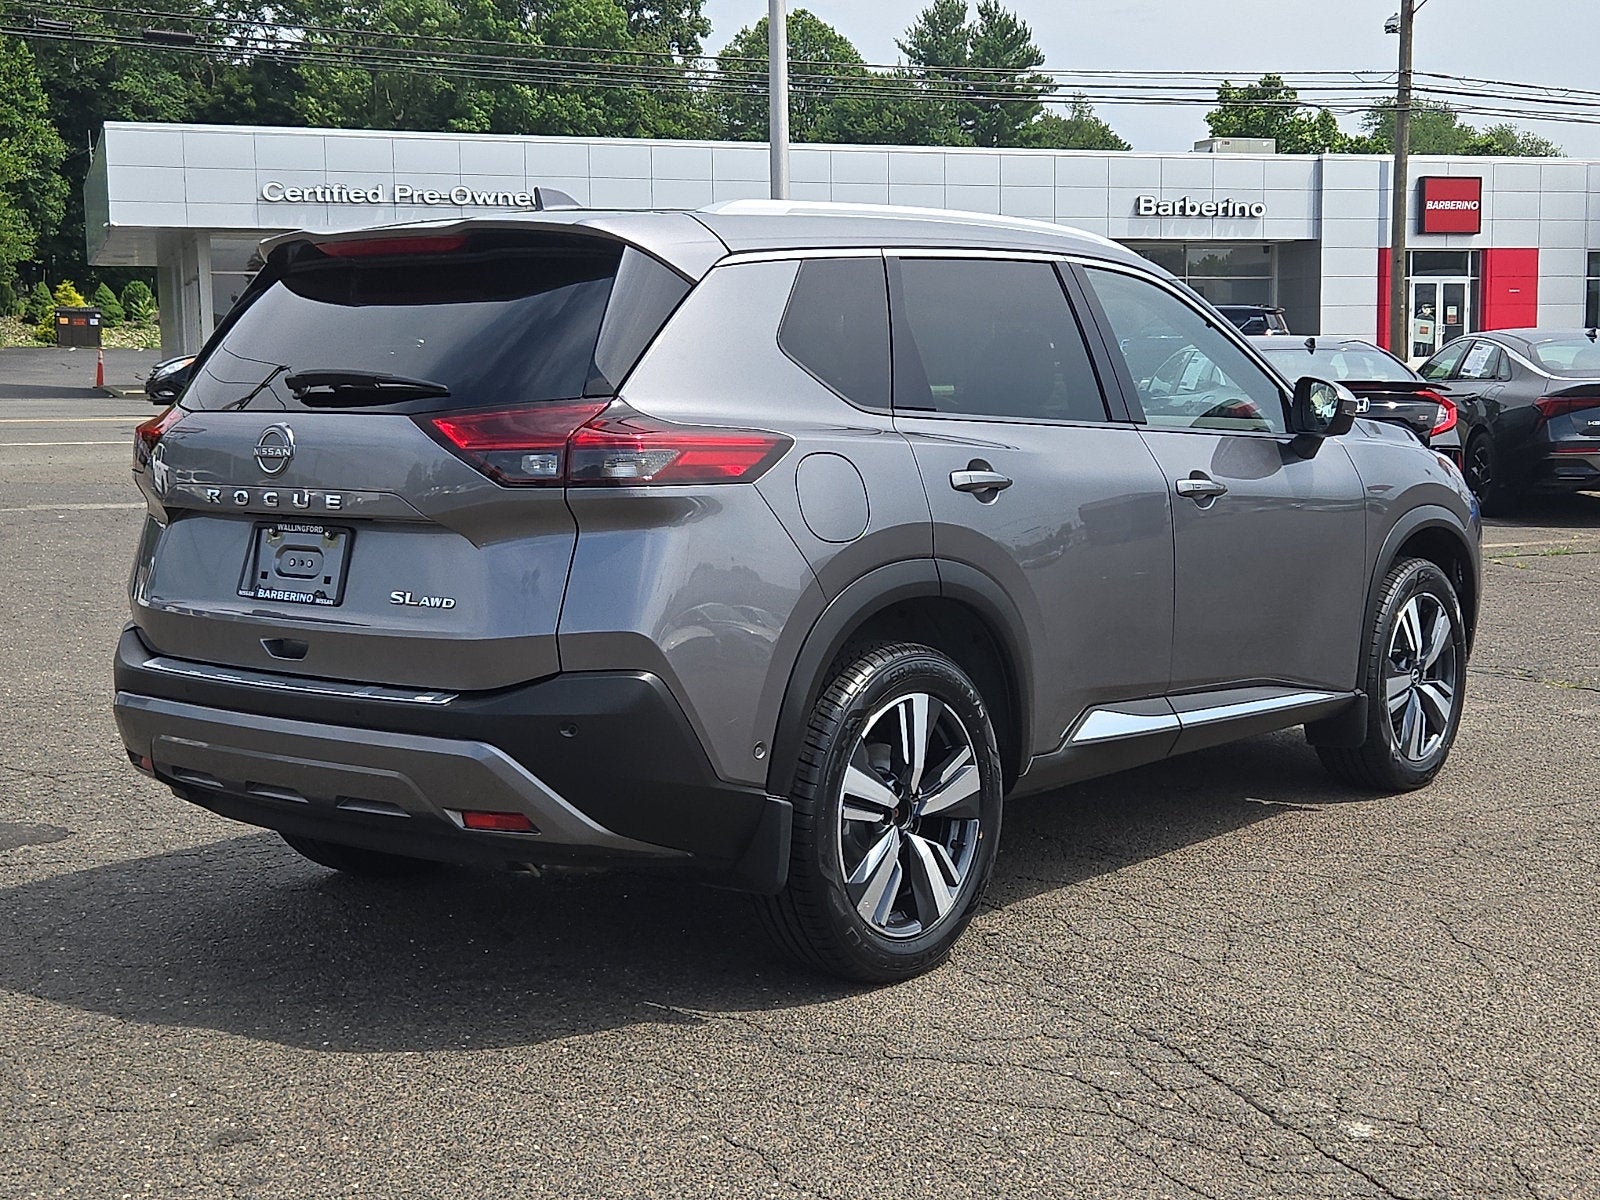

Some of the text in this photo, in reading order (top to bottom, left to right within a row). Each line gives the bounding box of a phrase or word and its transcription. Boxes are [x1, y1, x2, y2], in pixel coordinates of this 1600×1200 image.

[262, 182, 536, 207] Certified Pre-Owne
[1137, 194, 1267, 217] Barberino
[1425, 200, 1479, 210] BARBERINO
[253, 447, 291, 456] NISSAN
[206, 488, 342, 509] ROGUE
[277, 523, 324, 533] WALLINGFORD
[257, 588, 314, 603] BARBERINO
